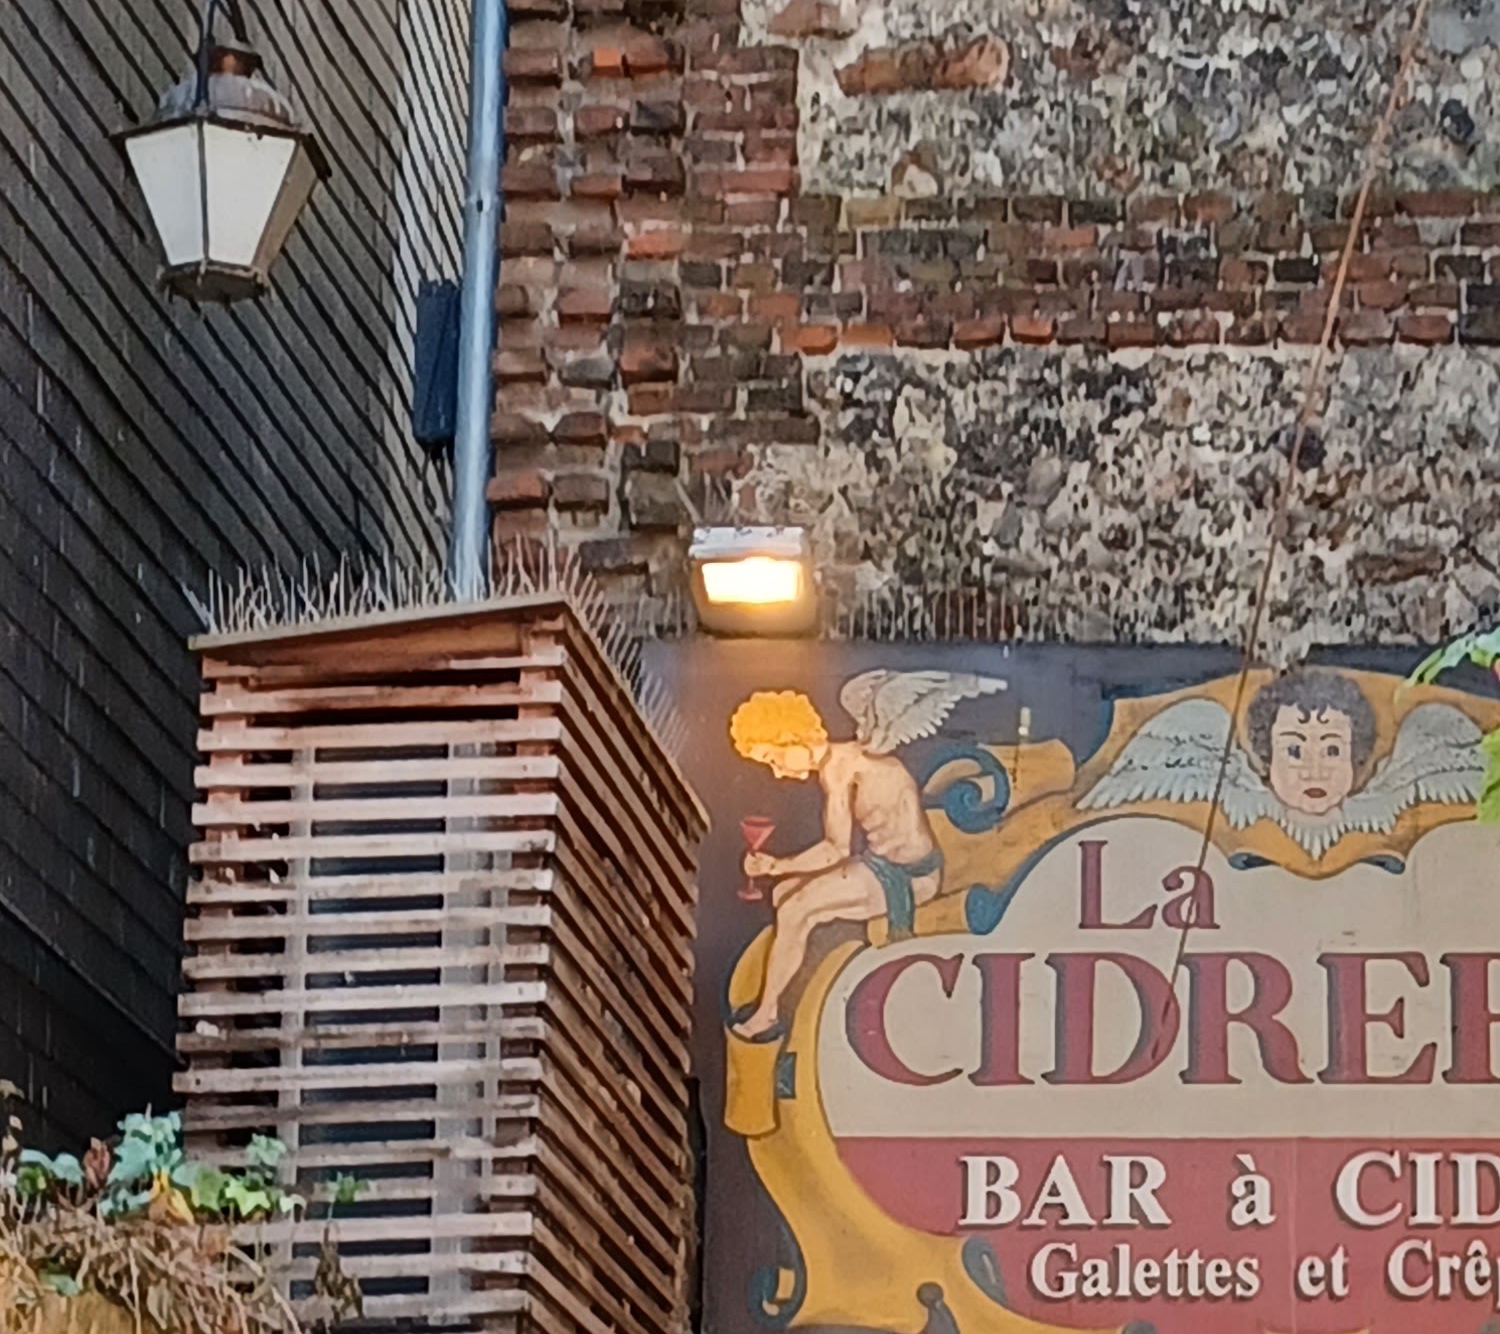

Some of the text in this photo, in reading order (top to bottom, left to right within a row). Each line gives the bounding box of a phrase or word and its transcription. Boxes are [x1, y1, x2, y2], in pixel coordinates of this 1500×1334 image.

[1077, 839, 1220, 931] La
[957, 1154, 1172, 1227] BAR
[1231, 1153, 1276, 1227] à
[1031, 1242, 1261, 1299] Galettes
[1298, 1246, 1350, 1297] et
